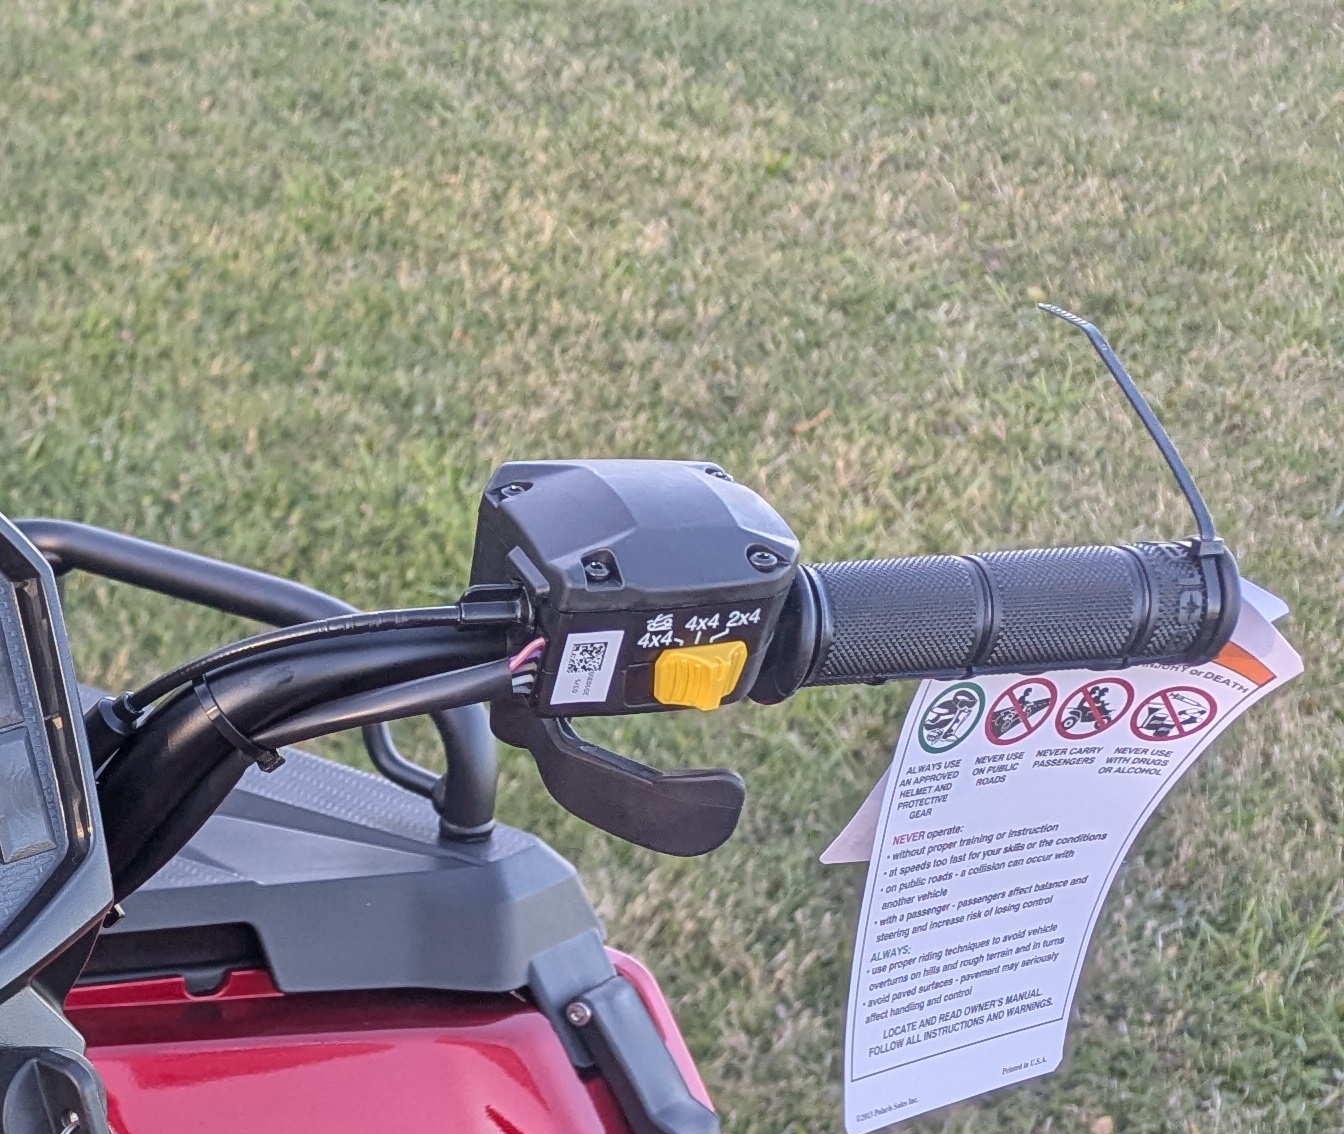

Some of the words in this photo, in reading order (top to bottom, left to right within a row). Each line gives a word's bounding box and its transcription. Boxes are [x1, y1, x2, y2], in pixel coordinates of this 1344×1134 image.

[685, 613, 720, 632] 4x4
[727, 608, 762, 628] 2x4
[637, 631, 673, 649] 4x4
[1203, 671, 1249, 694] DEATH
[868, 1037, 904, 1057] FOLLOW
[905, 1033, 922, 1046] ALL
[923, 1015, 984, 1040] INSTRUCTIONS
[985, 1010, 1005, 1023] AND
[882, 1020, 917, 1039] LOCATE
[918, 1015, 937, 1029] AND
[938, 1008, 962, 1023] READ
